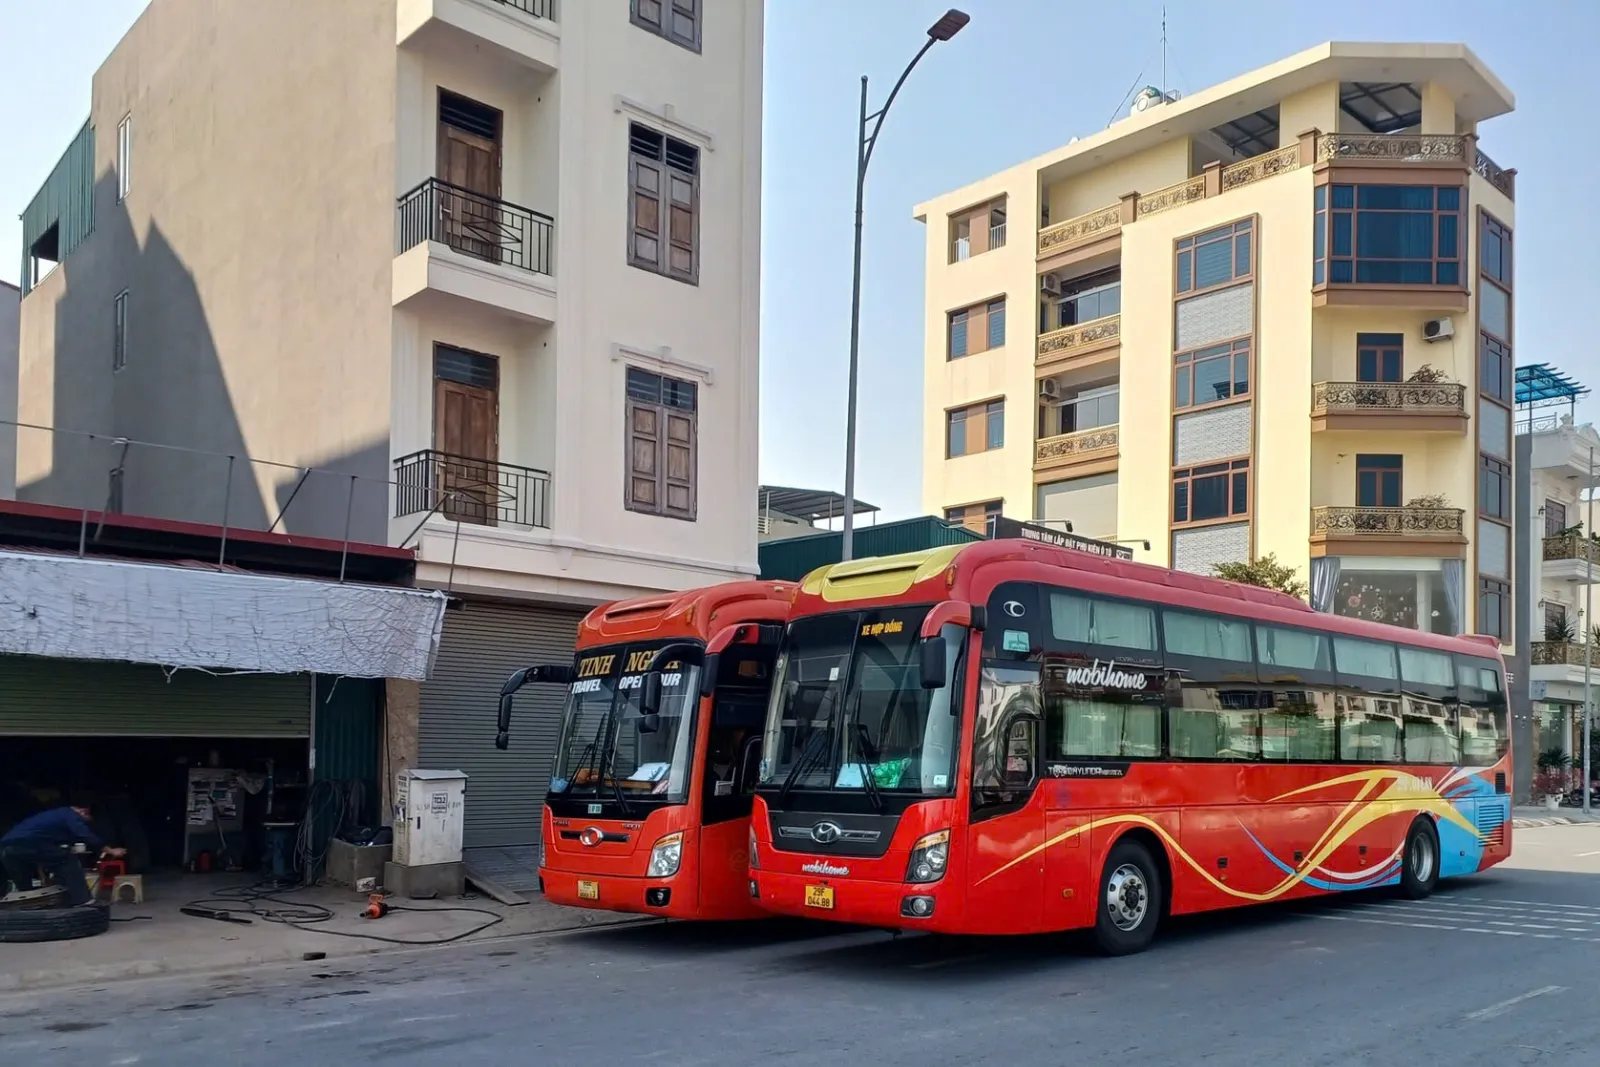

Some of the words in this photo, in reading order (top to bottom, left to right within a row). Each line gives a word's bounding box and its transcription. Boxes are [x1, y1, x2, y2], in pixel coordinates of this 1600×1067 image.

[1021, 528, 1040, 541] TRUNG
[861, 624, 871, 636] XE
[1066, 658, 1148, 690] mobihome
[571, 679, 602, 695] TRAVEL
[802, 859, 850, 876] mobihome
[813, 887, 825, 896] 29F
[807, 896, 830, 907] 044.88
